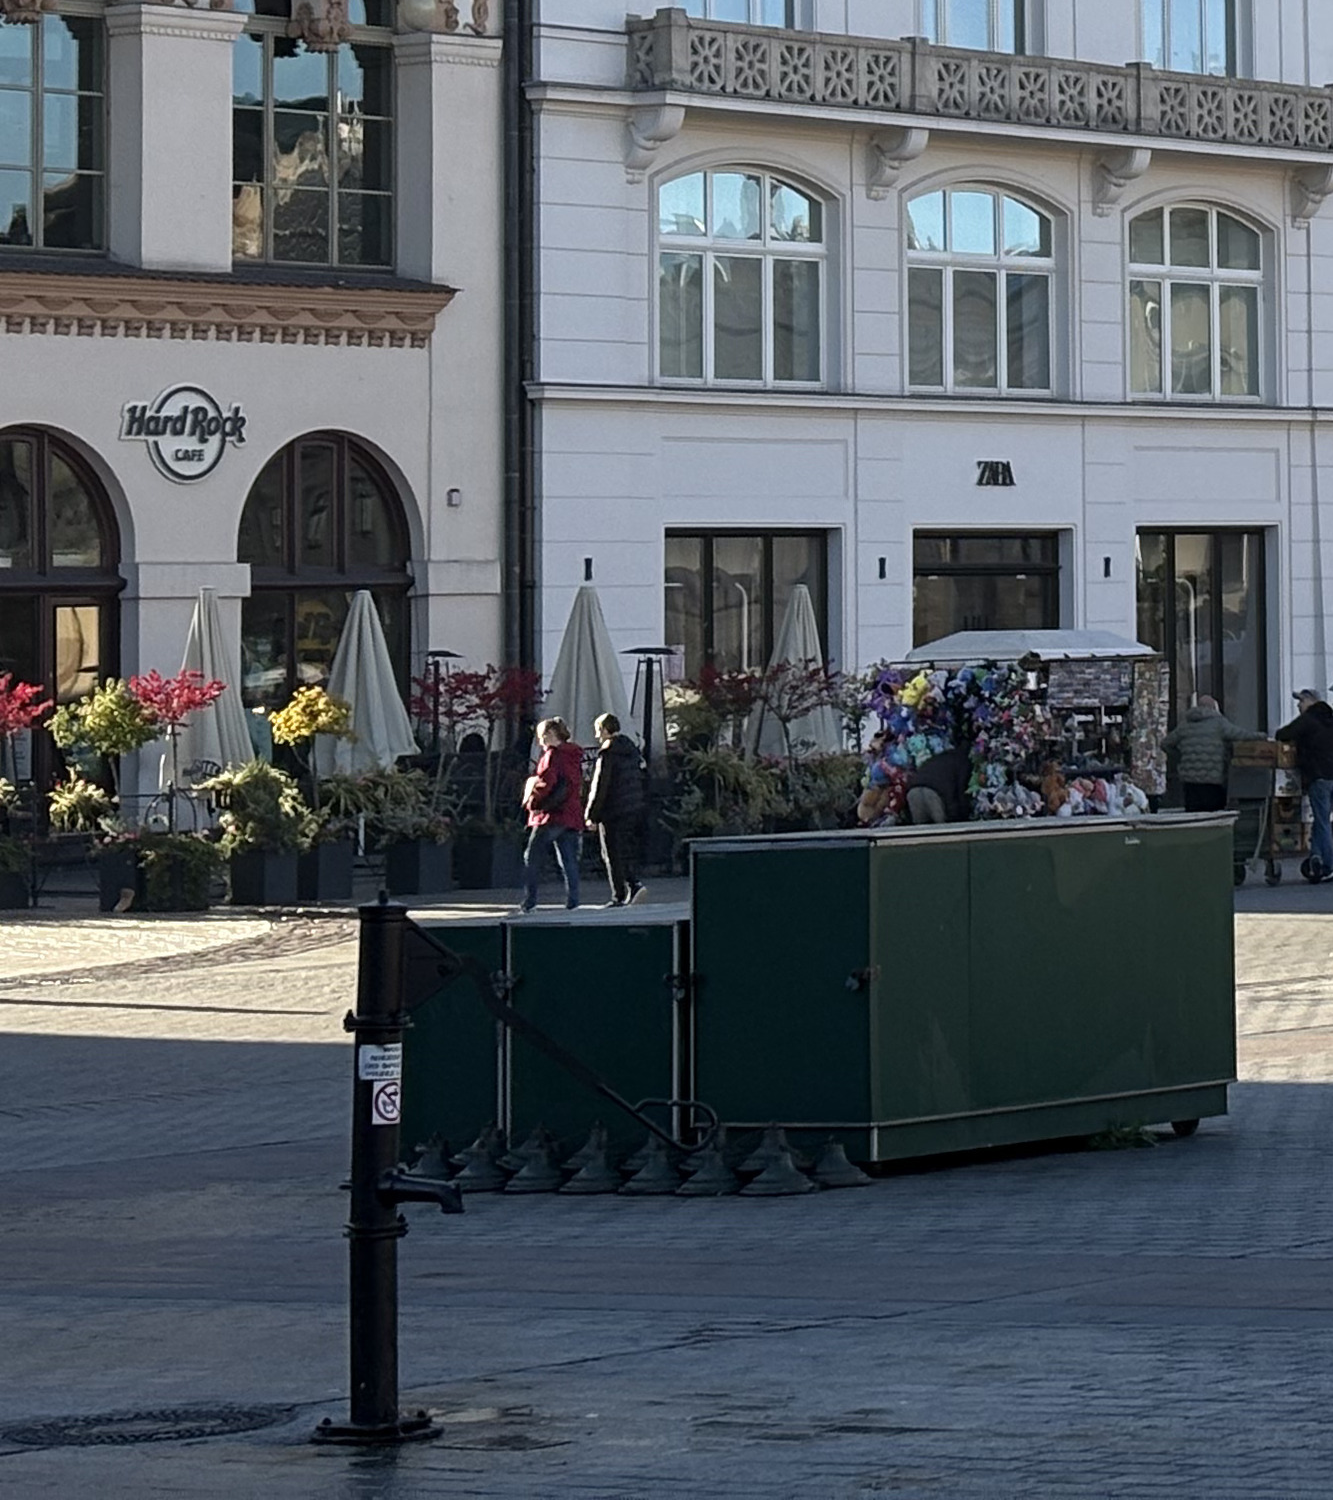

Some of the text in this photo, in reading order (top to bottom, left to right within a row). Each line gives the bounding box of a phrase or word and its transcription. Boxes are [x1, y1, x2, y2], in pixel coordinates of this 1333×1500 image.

[125, 405, 247, 444] Hard Rock
[174, 448, 205, 462] CAFE
[976, 460, 1017, 487] ZARA
